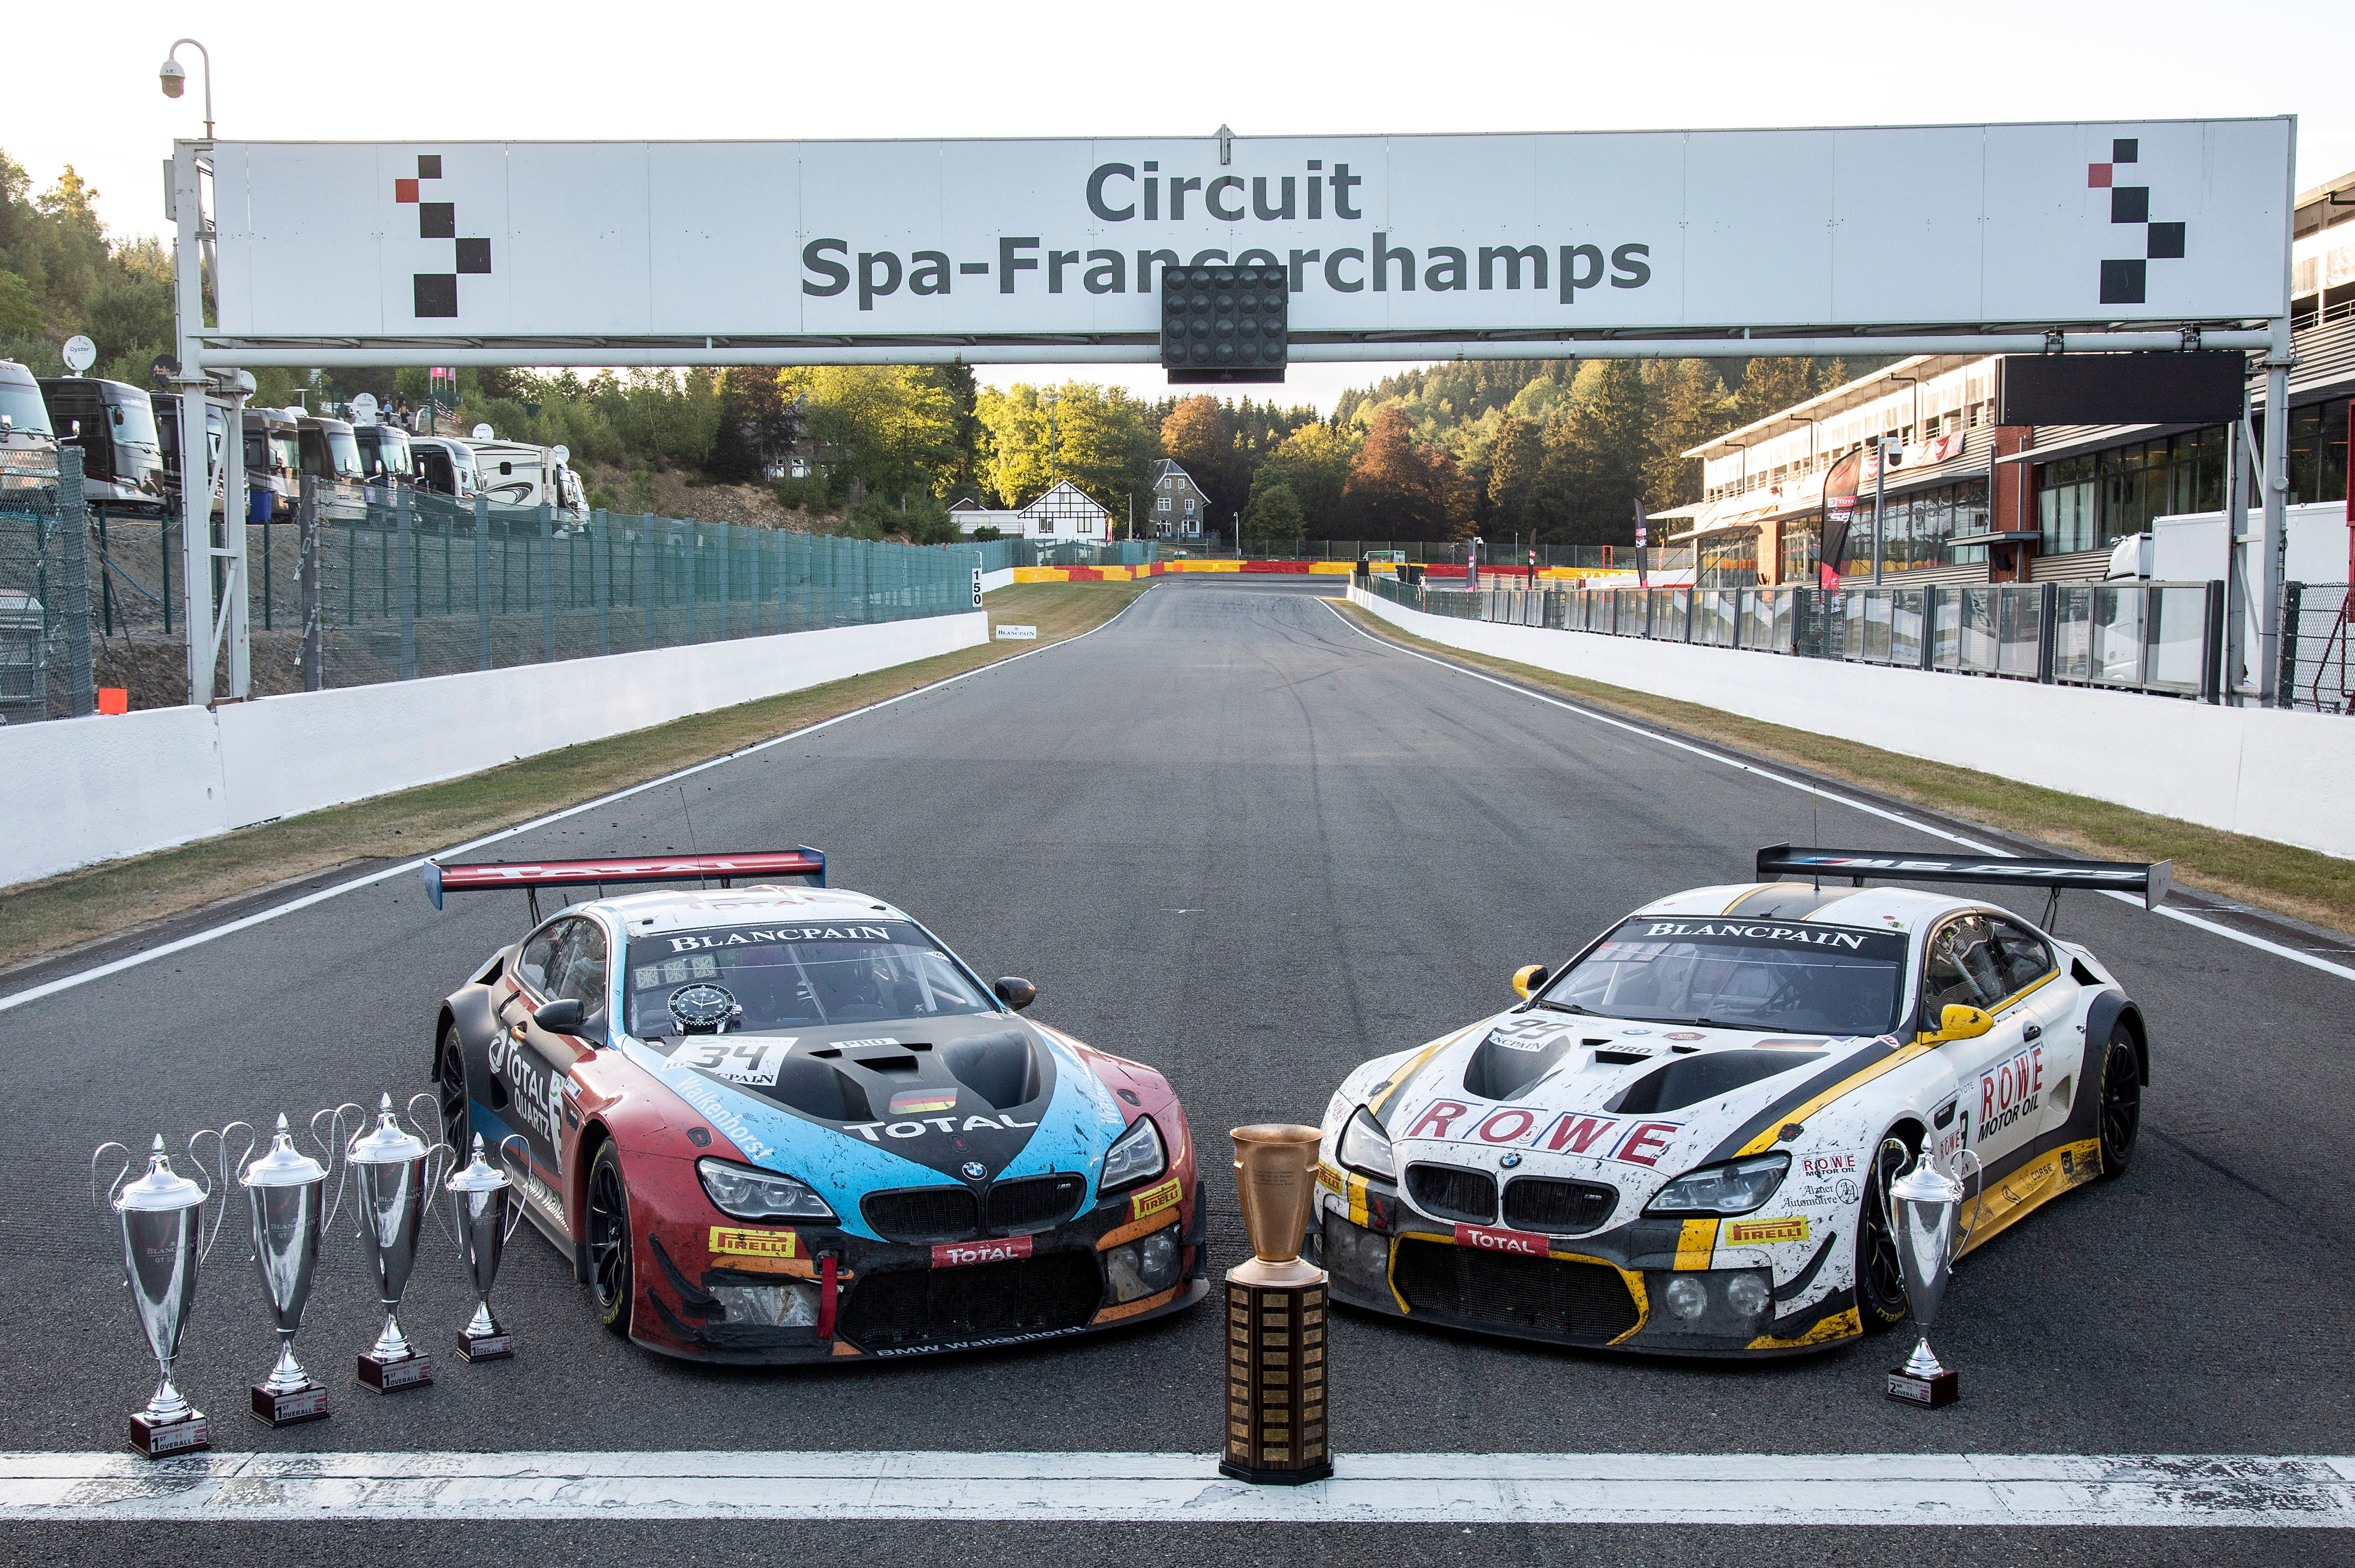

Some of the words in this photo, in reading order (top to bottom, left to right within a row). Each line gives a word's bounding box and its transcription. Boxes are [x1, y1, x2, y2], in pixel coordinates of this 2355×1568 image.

[1087, 160, 1361, 221] Circuit
[973, 570, 981, 604] 150
[674, 896, 838, 911] TOTAL
[665, 926, 890, 953] BLANCPAIN
[1646, 922, 1868, 949] BLANCPAIN
[1493, 1019, 1575, 1039] 99
[841, 1039, 887, 1047] PRO
[1606, 1045, 1653, 1054] PRO
[688, 1046, 769, 1070] 34
[507, 1037, 549, 1113] TOTAL
[1960, 1081, 1974, 1095] YOTE
[1981, 1048, 2043, 1124] ROWE
[514, 1087, 551, 1142] QUARTZ
[676, 1076, 774, 1160] Walkenhorst
[1977, 1104, 2020, 1143] MOTOR
[2022, 1093, 2038, 1116] OIL
[843, 1114, 1038, 1142] TOTAL
[1408, 1101, 1677, 1167] ROWE
[1940, 1130, 1960, 1161] ROWE
[1803, 1156, 1856, 1171] ROWE
[1806, 1168, 1839, 1177] MOTOR
[2031, 1163, 2054, 1181] CORSE
[1138, 1183, 1179, 1214] PIRELLI
[1803, 1185, 1834, 1197] Alzner
[1781, 1196, 1837, 1209] Automotive
[1732, 1220, 1801, 1241] PIRELLI
[147, 1244, 194, 1255] BLANCIN
[717, 1232, 788, 1252] PIRELLI
[1467, 1229, 1536, 1253] TOTAL
[946, 1246, 1019, 1264] TOTAL
[877, 1344, 939, 1356] BMW
[944, 1325, 1086, 1350] Walkenhorst
[390, 1376, 418, 1385] OVERALL
[1896, 1389, 1919, 1399] OVERALL
[283, 1409, 313, 1418] OVERALL
[160, 1439, 192, 1450] OVERALL
